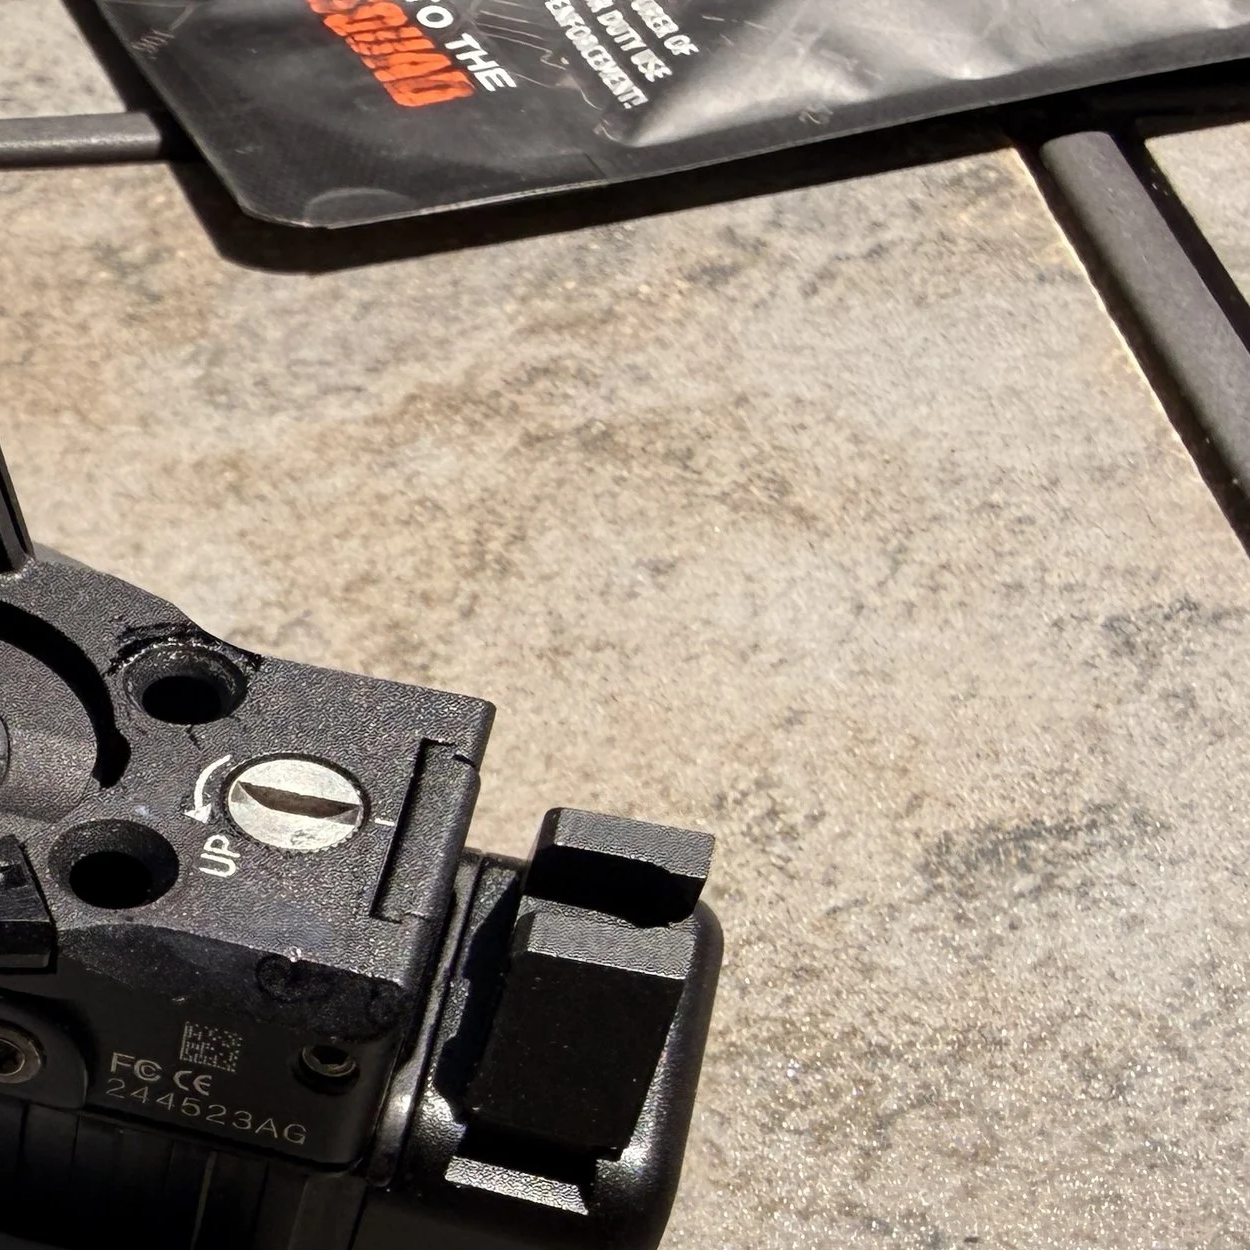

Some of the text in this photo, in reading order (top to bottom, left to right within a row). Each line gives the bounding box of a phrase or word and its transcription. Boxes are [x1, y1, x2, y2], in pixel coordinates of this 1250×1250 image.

[307, 0, 475, 108] QUAD
[444, 33, 517, 92] THE
[596, 9, 647, 51] DUTY
[630, 48, 673, 83] USE
[663, 34, 699, 56] OF
[198, 833, 243, 878] UP
[104, 1077, 308, 1146] 244523AG
[172, 1070, 213, 1097] CE
